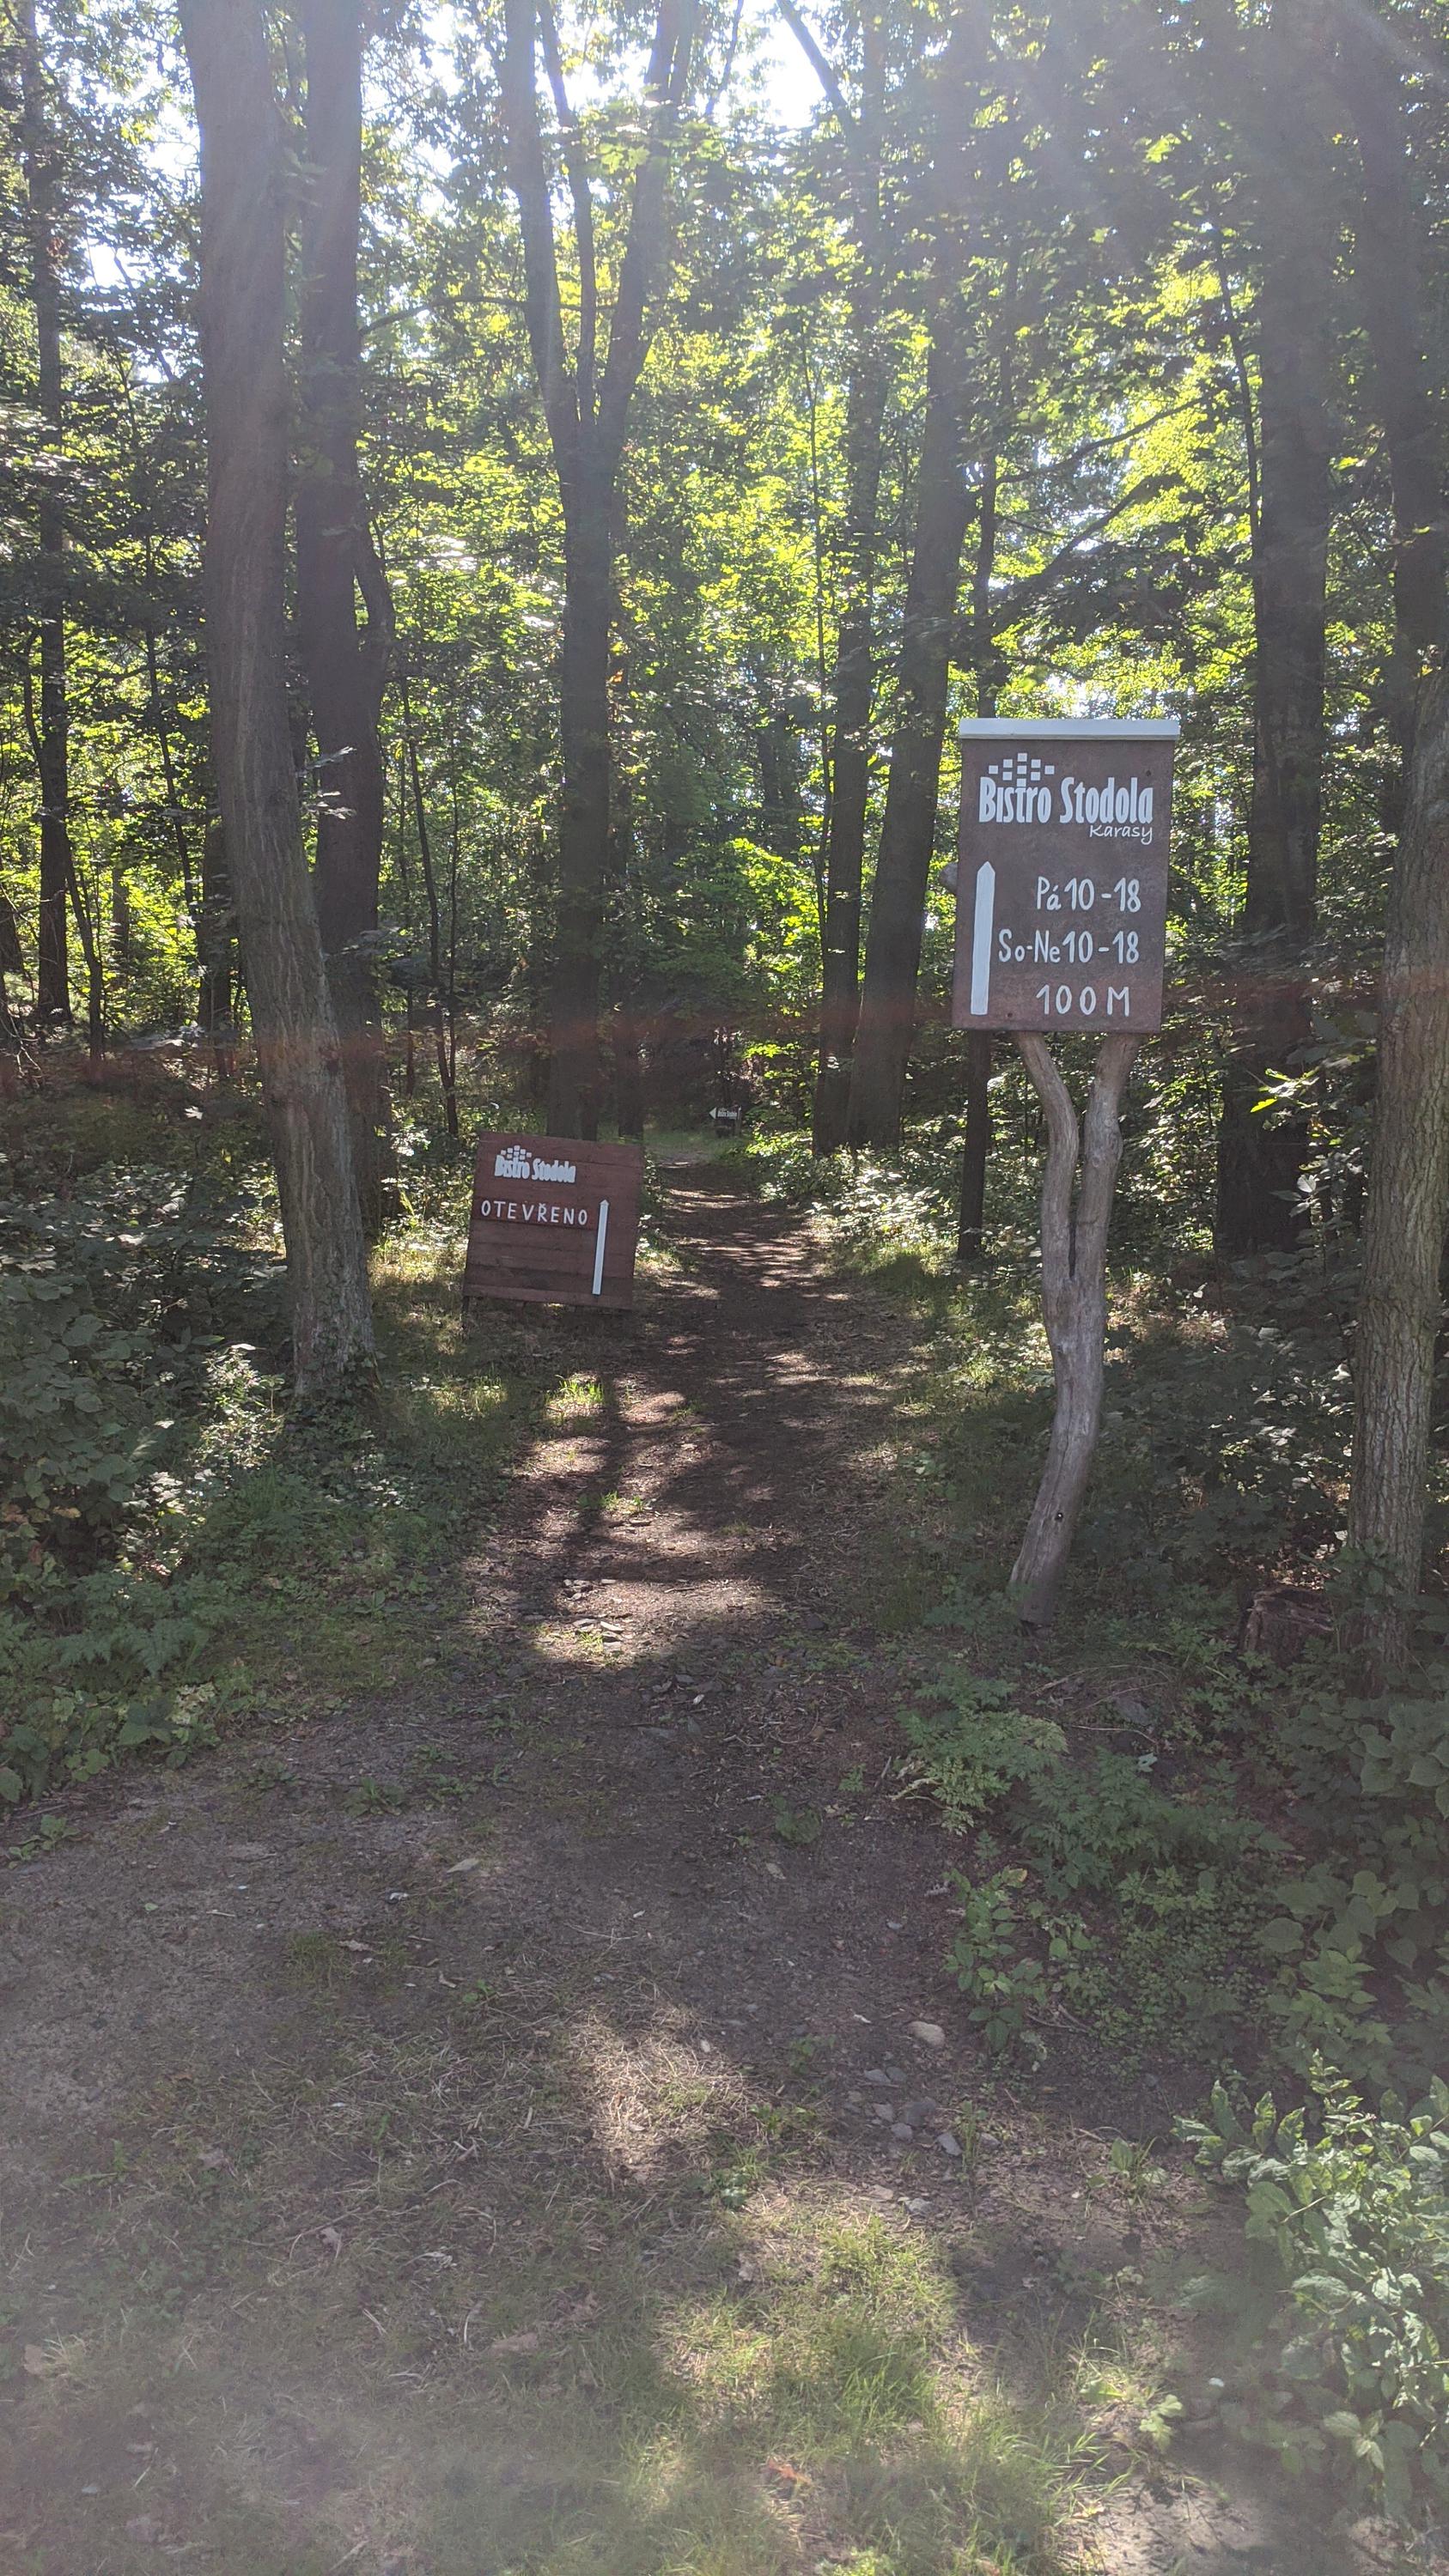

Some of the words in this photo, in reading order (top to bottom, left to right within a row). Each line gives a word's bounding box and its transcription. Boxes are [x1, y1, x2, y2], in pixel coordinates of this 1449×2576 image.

[979, 776, 1052, 823] Bistro
[1059, 776, 1154, 823] Stodola
[1089, 824, 1153, 845] Karasy
[1037, 877, 1062, 911] Pá
[998, 929, 1061, 963] So-Ne
[1036, 984, 1096, 1016] 100
[1107, 986, 1129, 1017] M
[495, 1154, 530, 1179] Bistro
[532, 1158, 576, 1183] Stodola
[481, 1200, 588, 1225] OTEVŘENO
